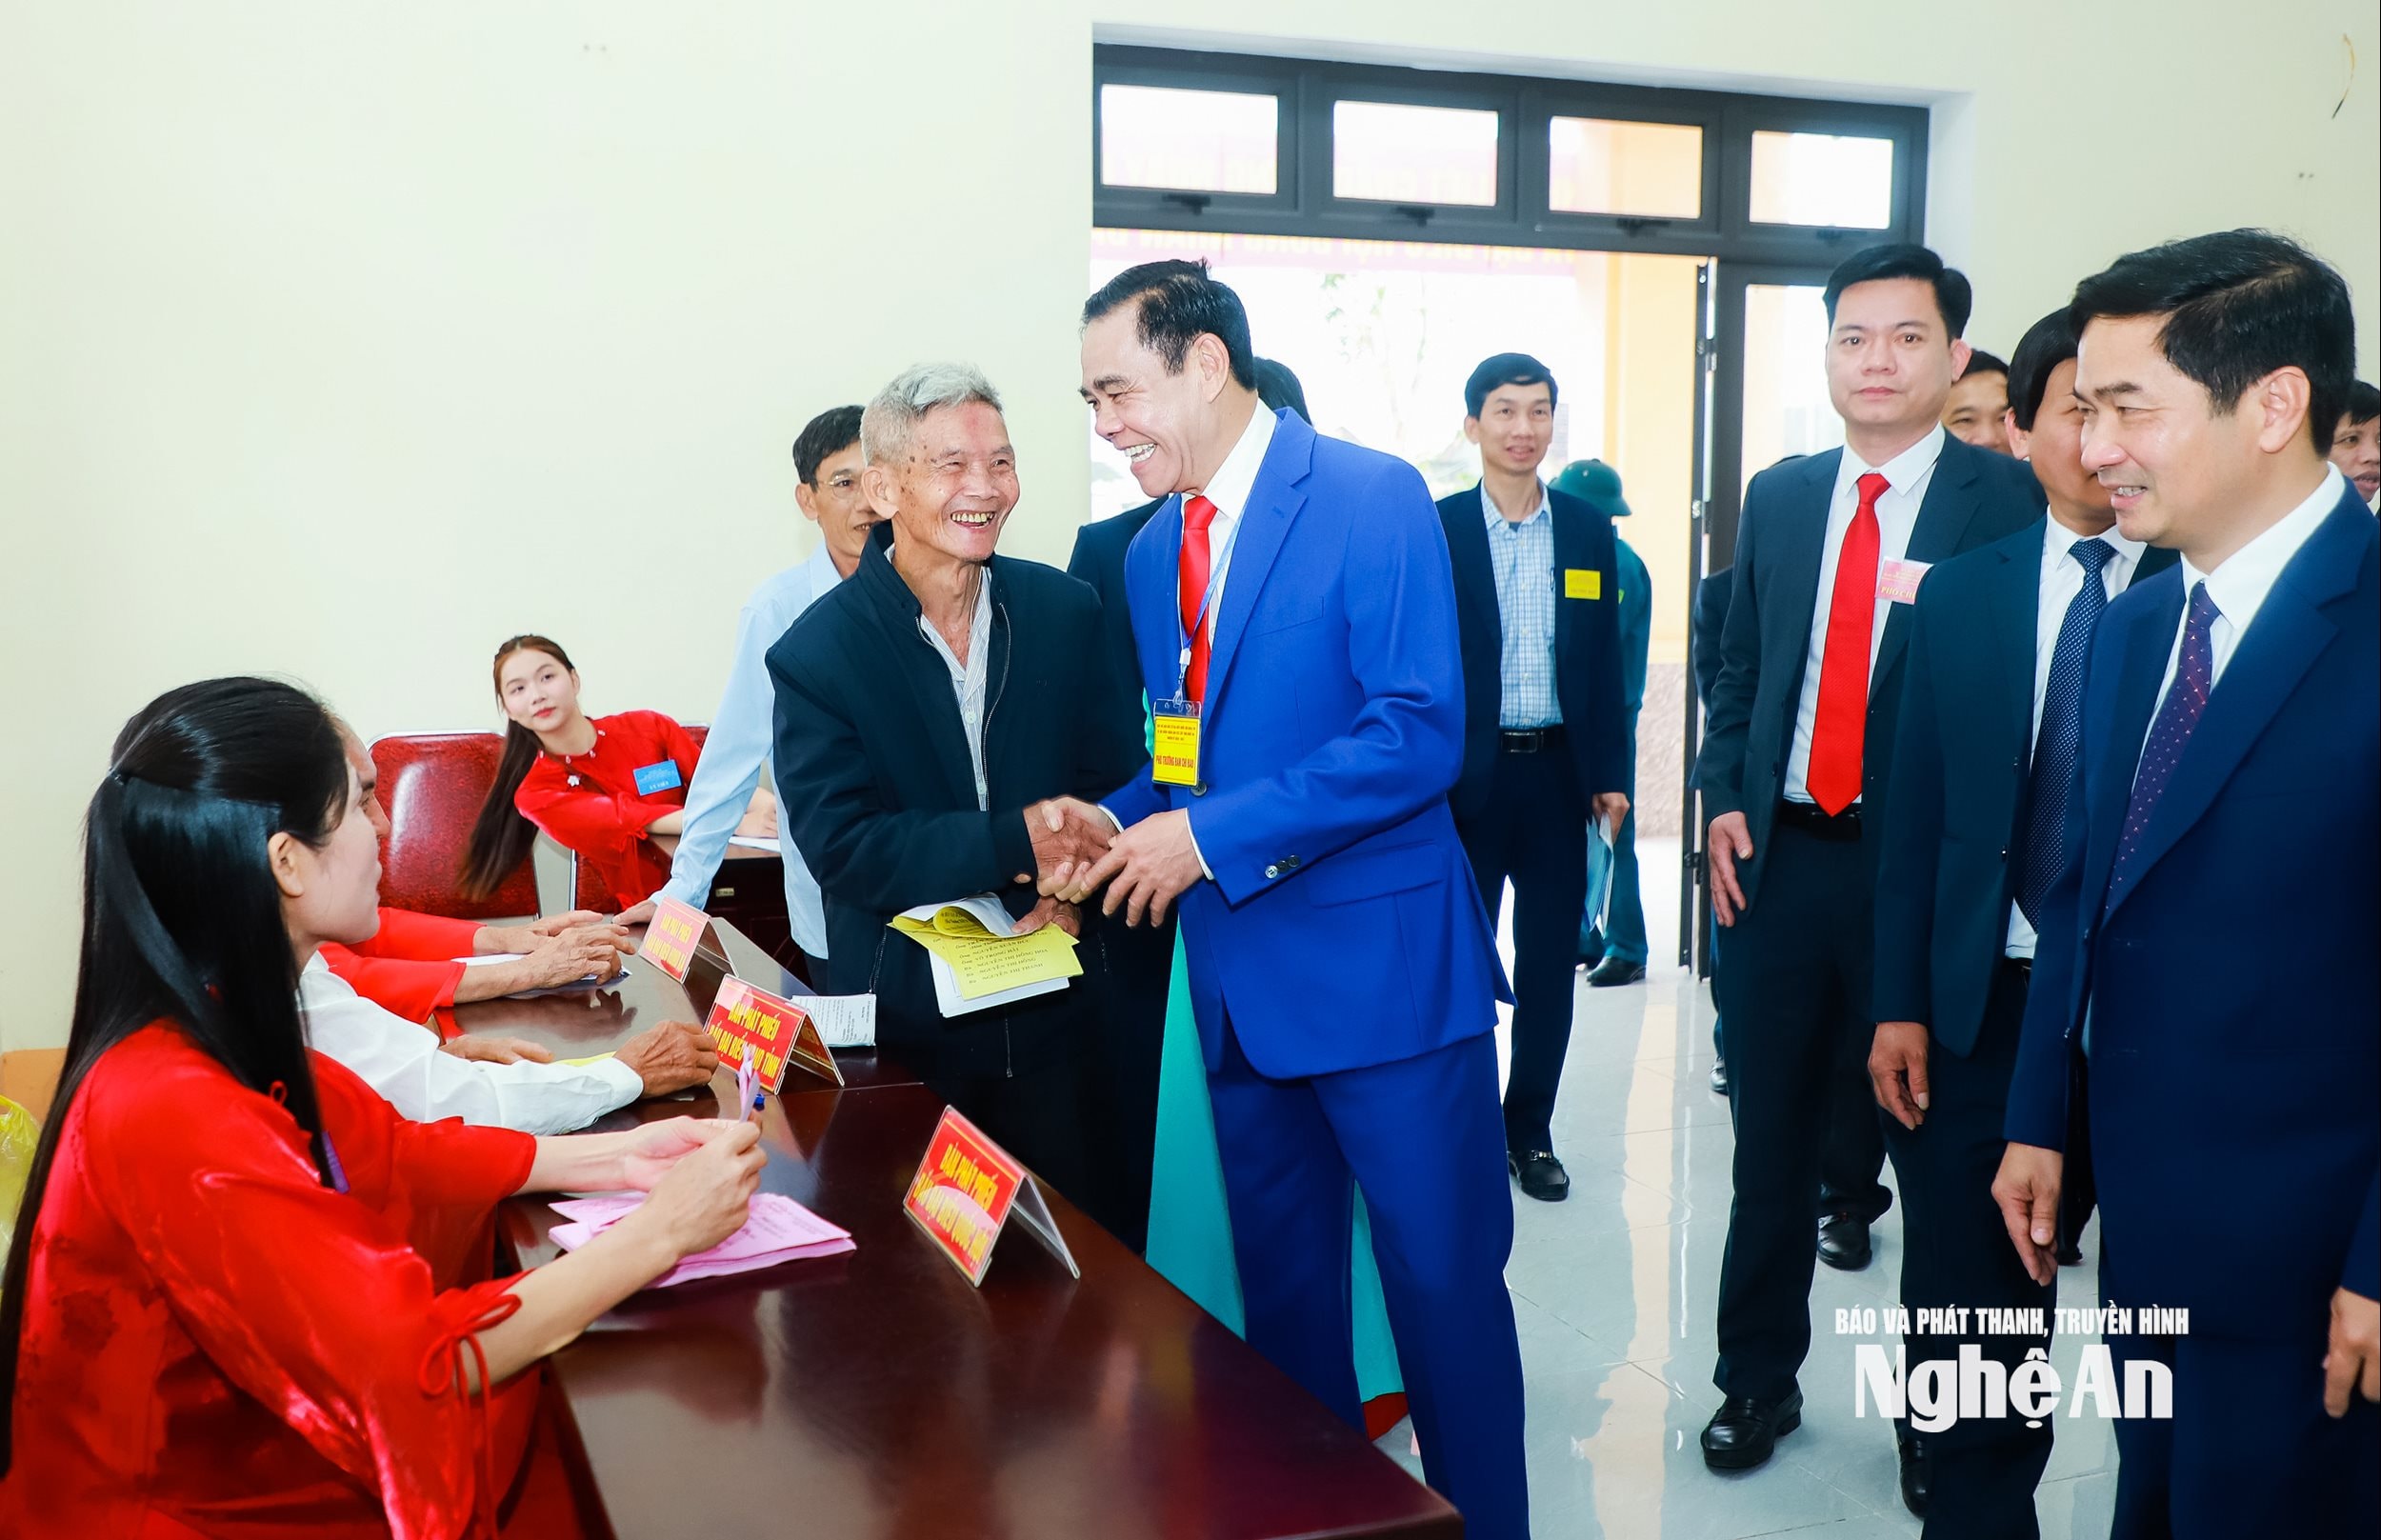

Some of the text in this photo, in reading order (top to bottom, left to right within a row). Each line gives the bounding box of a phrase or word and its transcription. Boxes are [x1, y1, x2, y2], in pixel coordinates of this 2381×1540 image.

[741, 1005, 762, 1032] PHÁT
[756, 1012, 781, 1042] PHIẾU
[761, 1047, 782, 1079] TỈNH
[952, 1158, 979, 1192] PHÁT
[970, 1173, 999, 1212] PHIẾU
